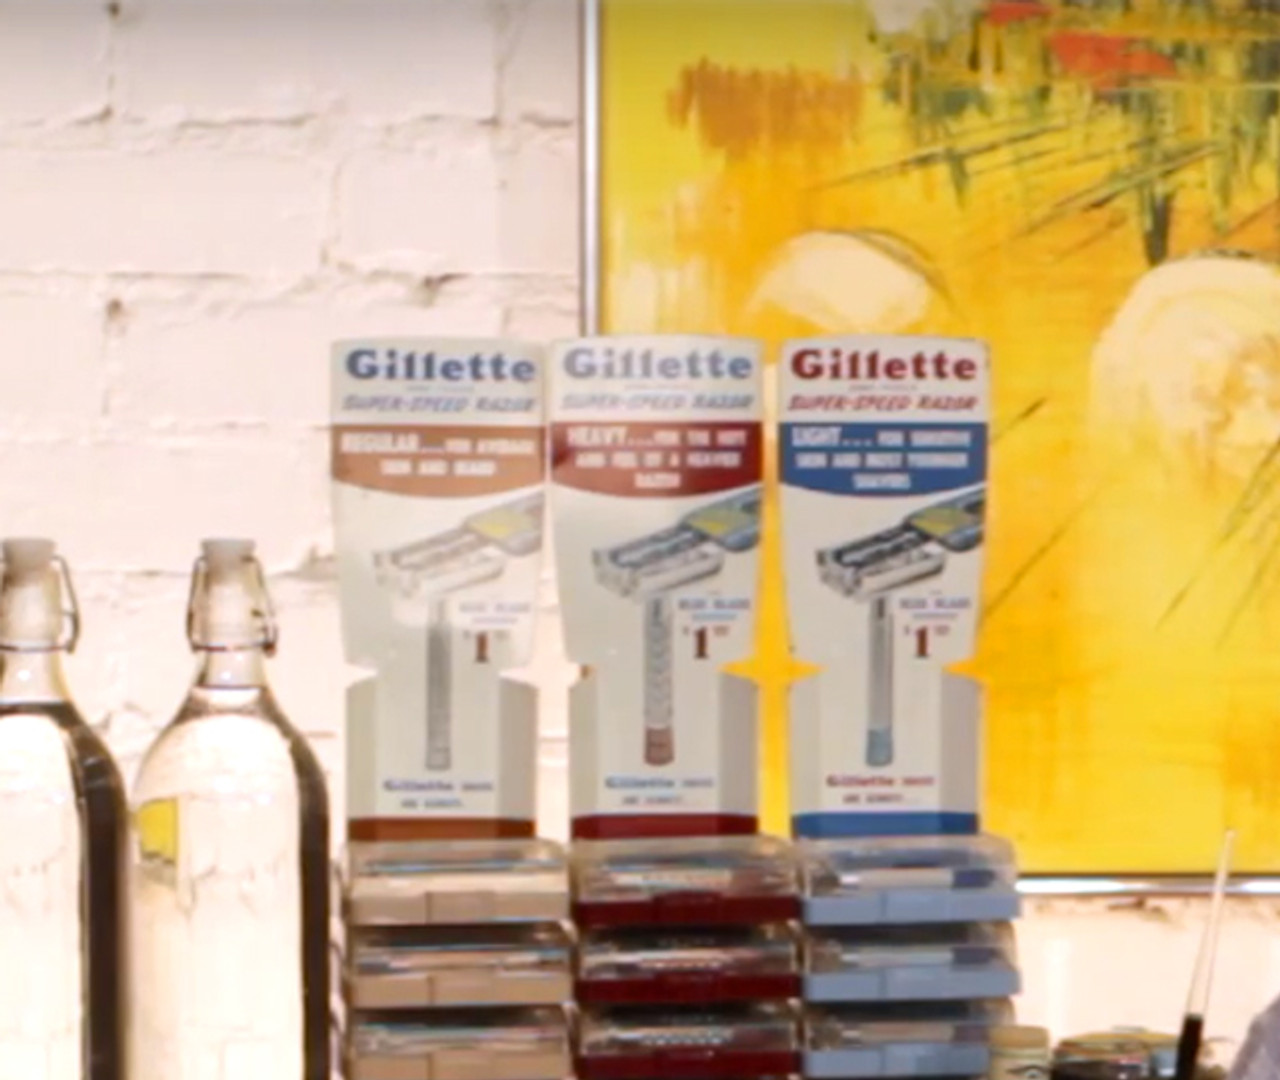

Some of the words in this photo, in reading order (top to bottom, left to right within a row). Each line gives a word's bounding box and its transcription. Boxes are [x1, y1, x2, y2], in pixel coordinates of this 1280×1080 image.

[346, 349, 536, 381] Gillette
[563, 348, 753, 379] Gillette
[790, 348, 977, 380] Gillette
